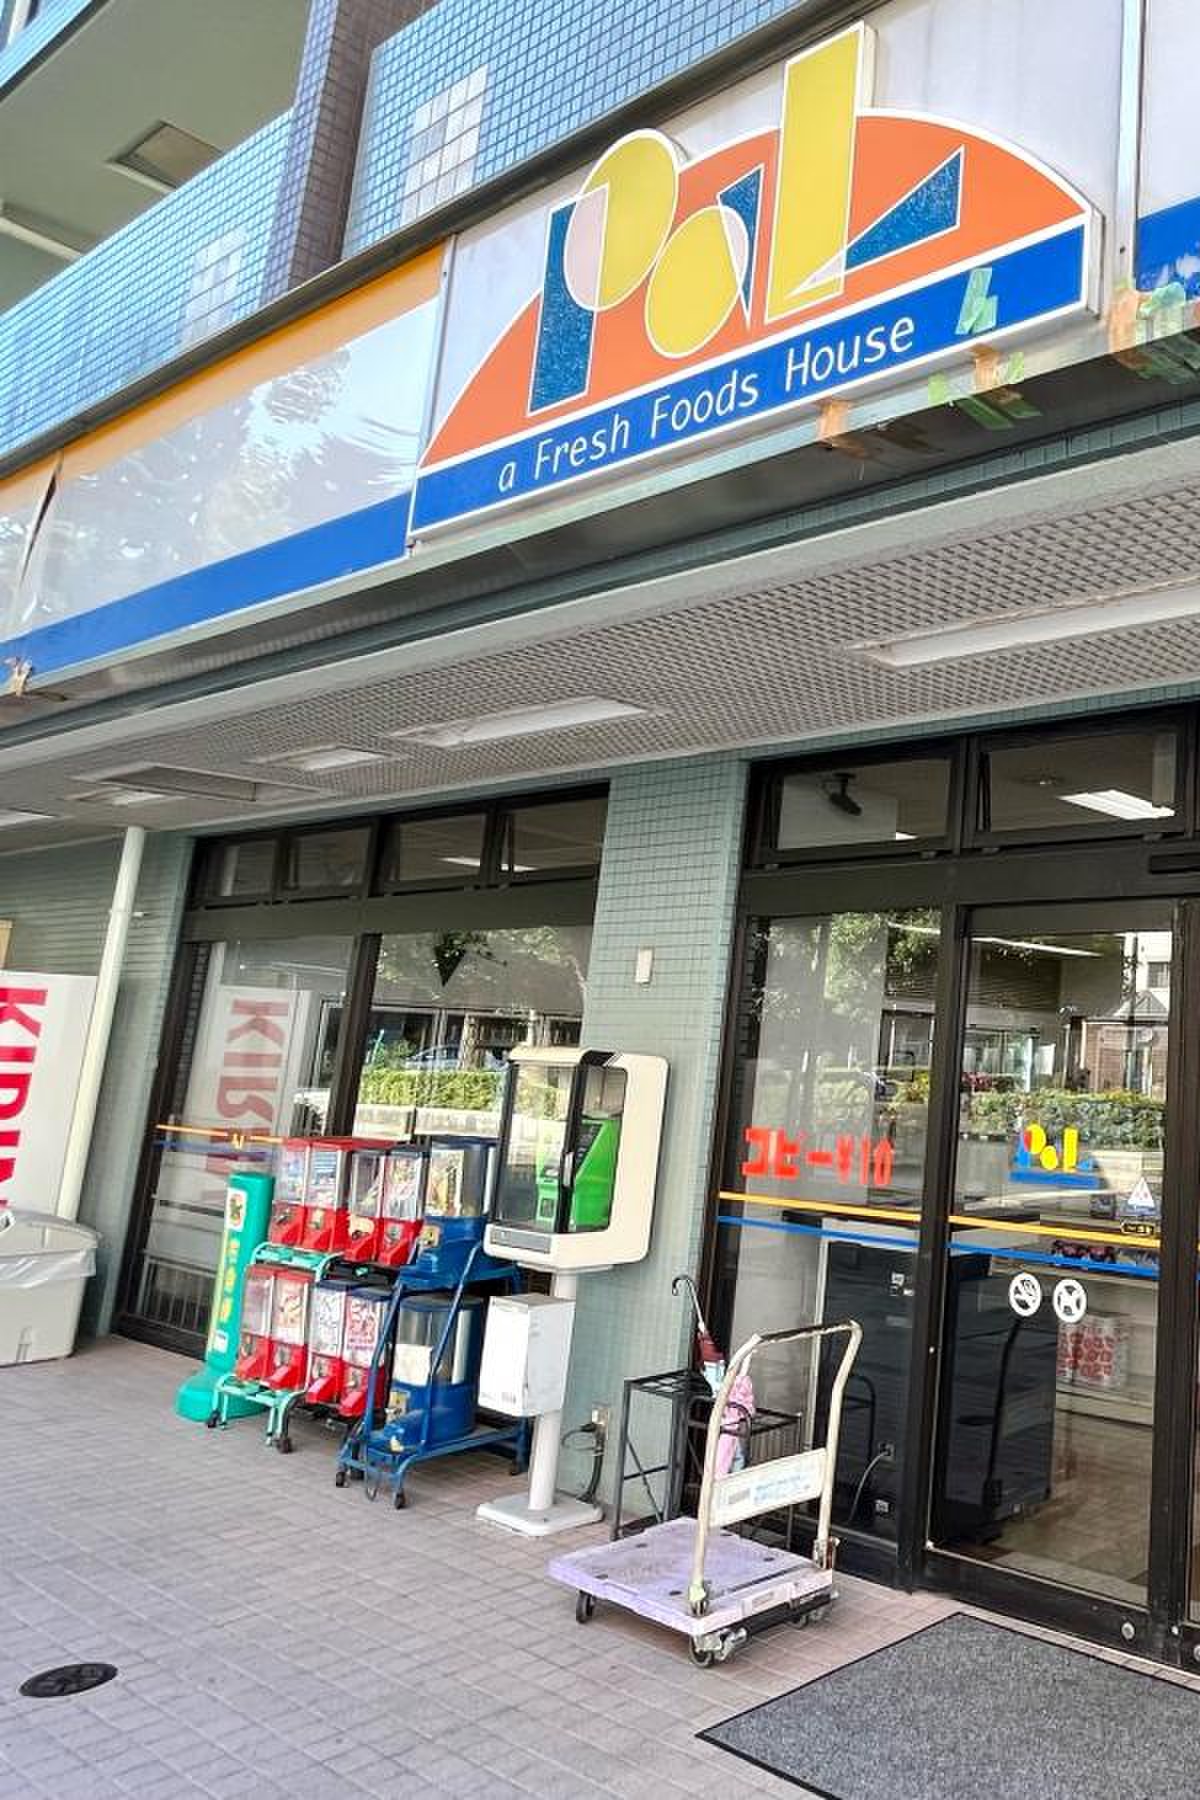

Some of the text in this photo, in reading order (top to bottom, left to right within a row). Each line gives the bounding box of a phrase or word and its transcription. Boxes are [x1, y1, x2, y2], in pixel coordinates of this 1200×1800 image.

[499, 313, 915, 491] a Fresh Foods House
